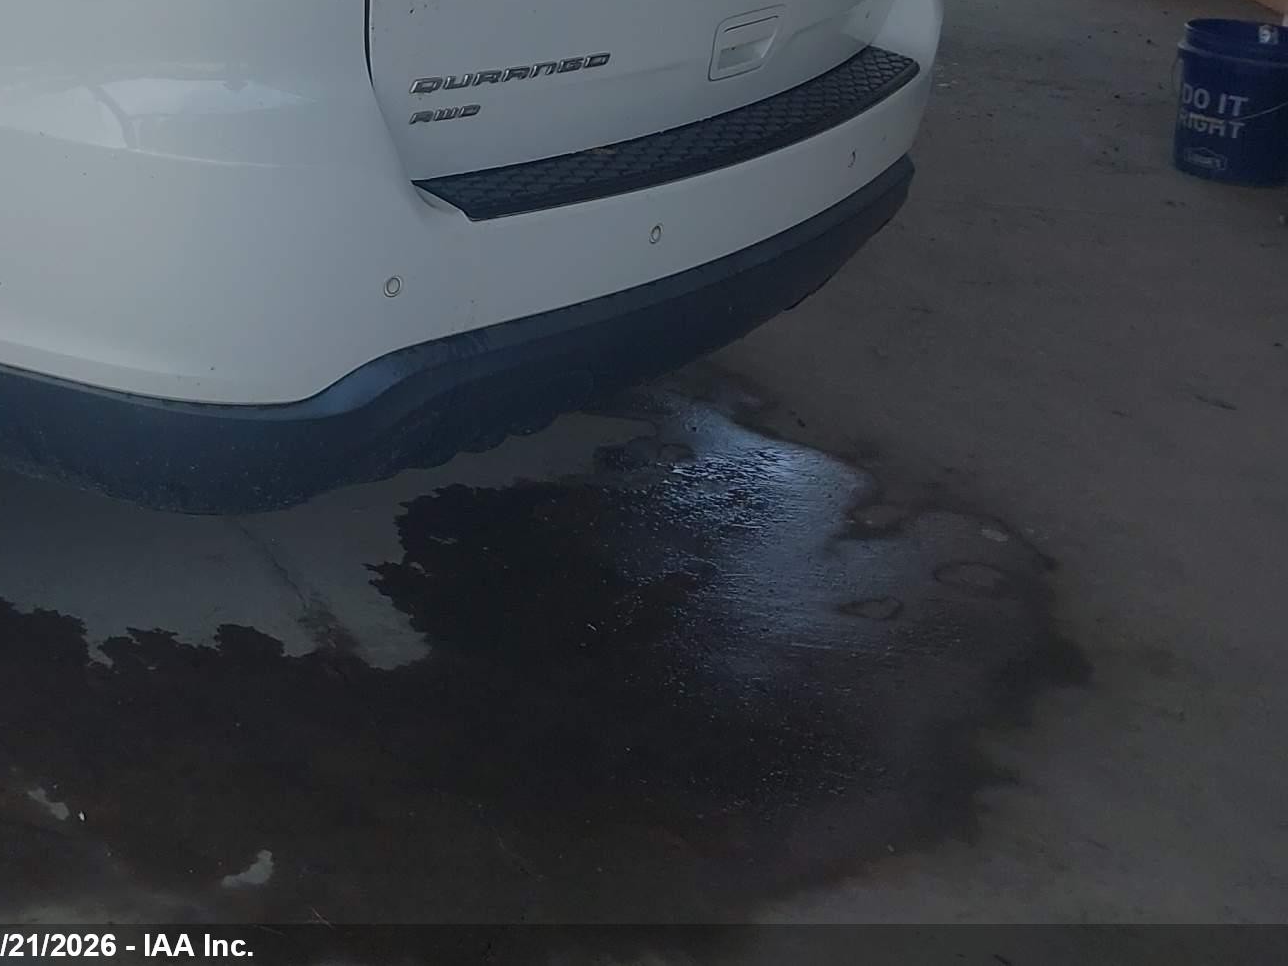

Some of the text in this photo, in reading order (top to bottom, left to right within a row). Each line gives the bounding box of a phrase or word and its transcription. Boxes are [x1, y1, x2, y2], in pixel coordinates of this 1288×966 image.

[409, 52, 611, 94] DURANGO
[409, 104, 481, 125] AWD
[1183, 83, 1249, 116] DO IT
[1180, 110, 1245, 139] RIGHT
